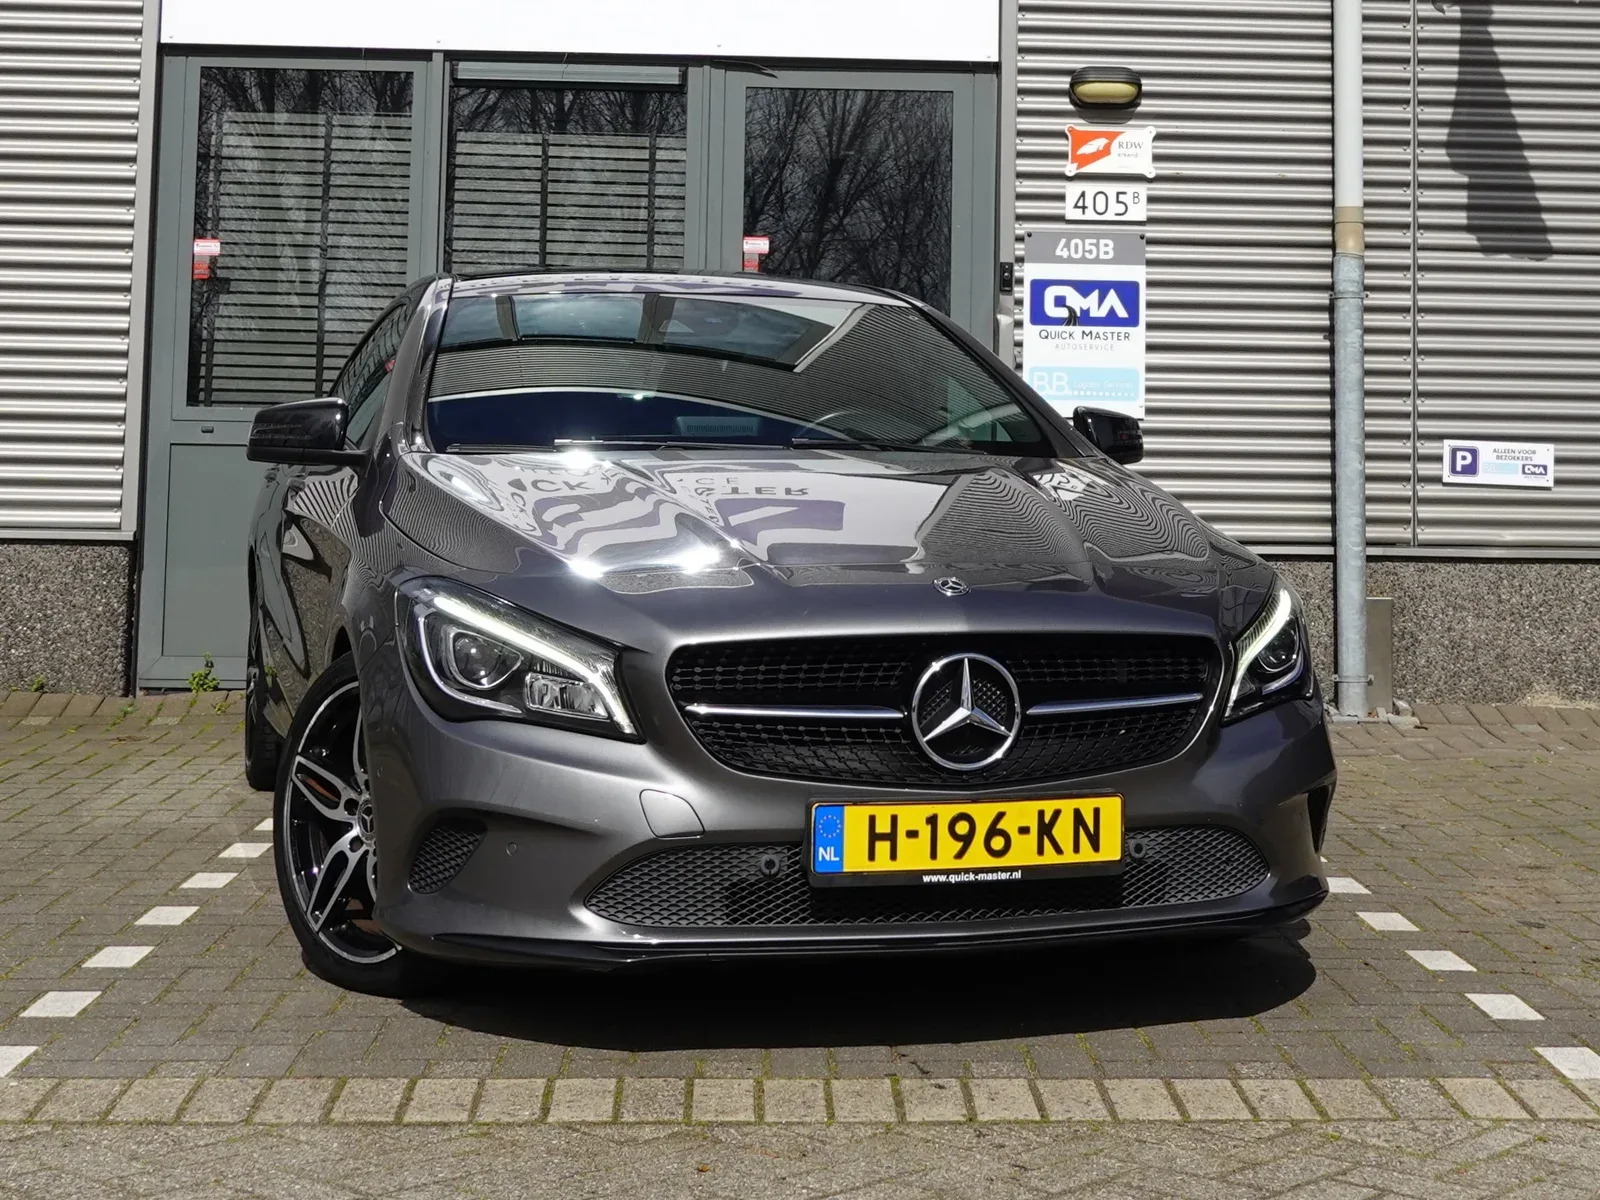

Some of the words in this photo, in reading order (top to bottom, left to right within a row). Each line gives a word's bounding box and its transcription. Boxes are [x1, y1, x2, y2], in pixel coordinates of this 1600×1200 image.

[1118, 140, 1143, 149] RDW
[1055, 238, 1114, 259] 405B
[1043, 285, 1129, 320] QMA
[1039, 329, 1075, 340] QUICK
[1081, 330, 1131, 341] MASTER
[1055, 343, 1115, 352] AUTOSERVICE
[1032, 371, 1071, 396] BB
[1456, 450, 1473, 472] P
[867, 807, 1101, 862] H-196-KN
[818, 847, 839, 861] NL
[922, 870, 1022, 883] www.quick-master.nl
